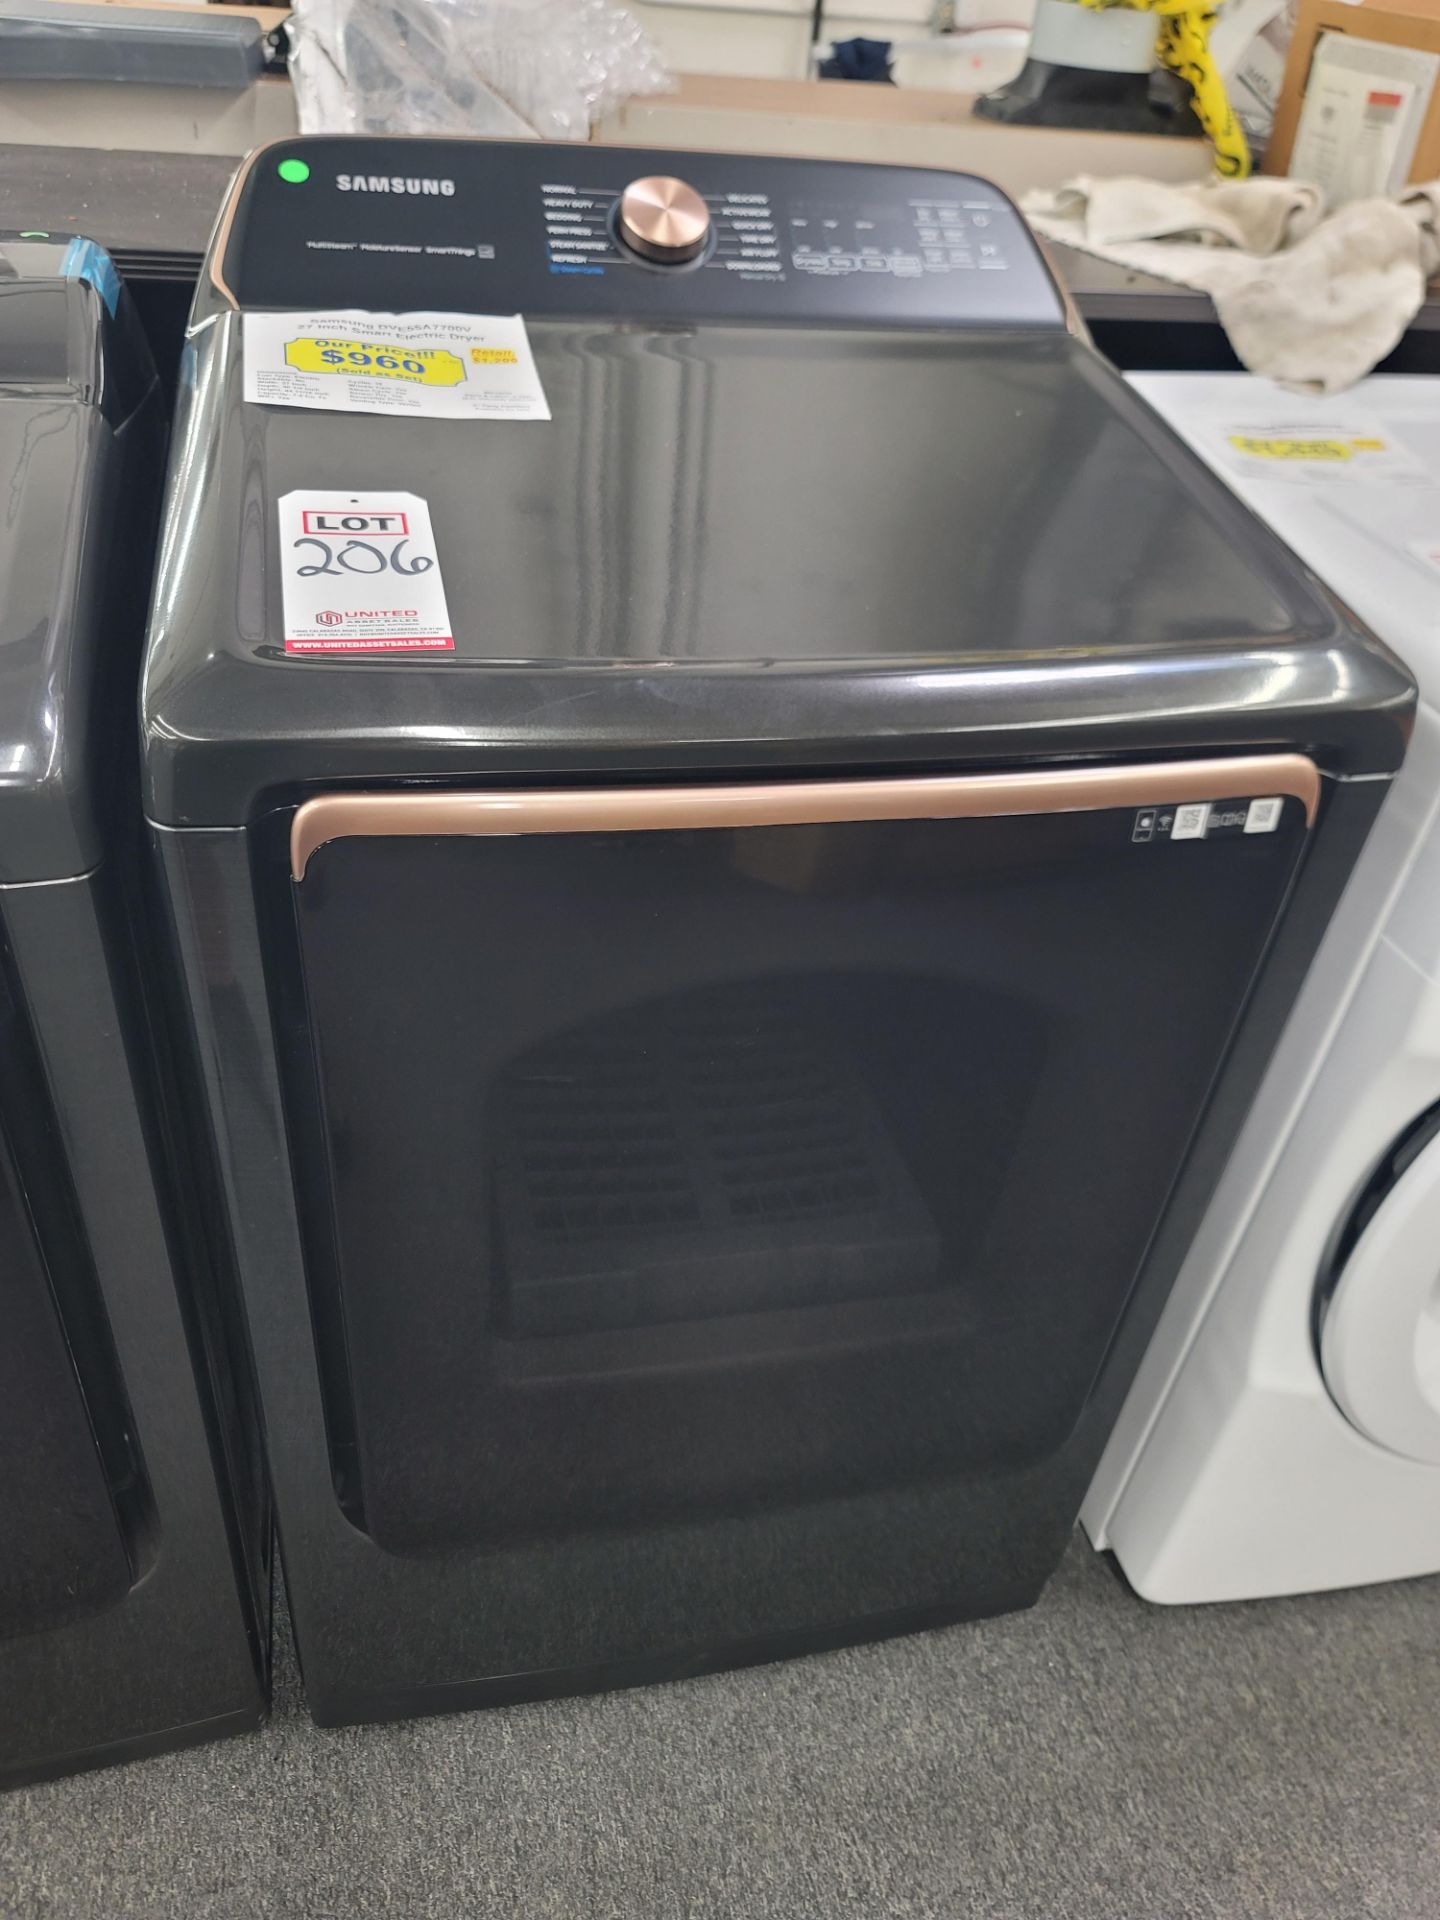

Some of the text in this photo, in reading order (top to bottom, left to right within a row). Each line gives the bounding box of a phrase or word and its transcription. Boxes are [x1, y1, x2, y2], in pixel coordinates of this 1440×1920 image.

[336, 174, 455, 196] SAMSUNG
[310, 318, 375, 331] Samsung
[352, 325, 393, 337] Smart
[396, 332, 443, 342] Electric
[449, 333, 486, 344] Dryer
[315, 339, 351, 348] Our
[321, 349, 427, 374] $960
[316, 516, 395, 531] LOT
[294, 538, 434, 577] 206
[345, 610, 418, 618] UNITED
